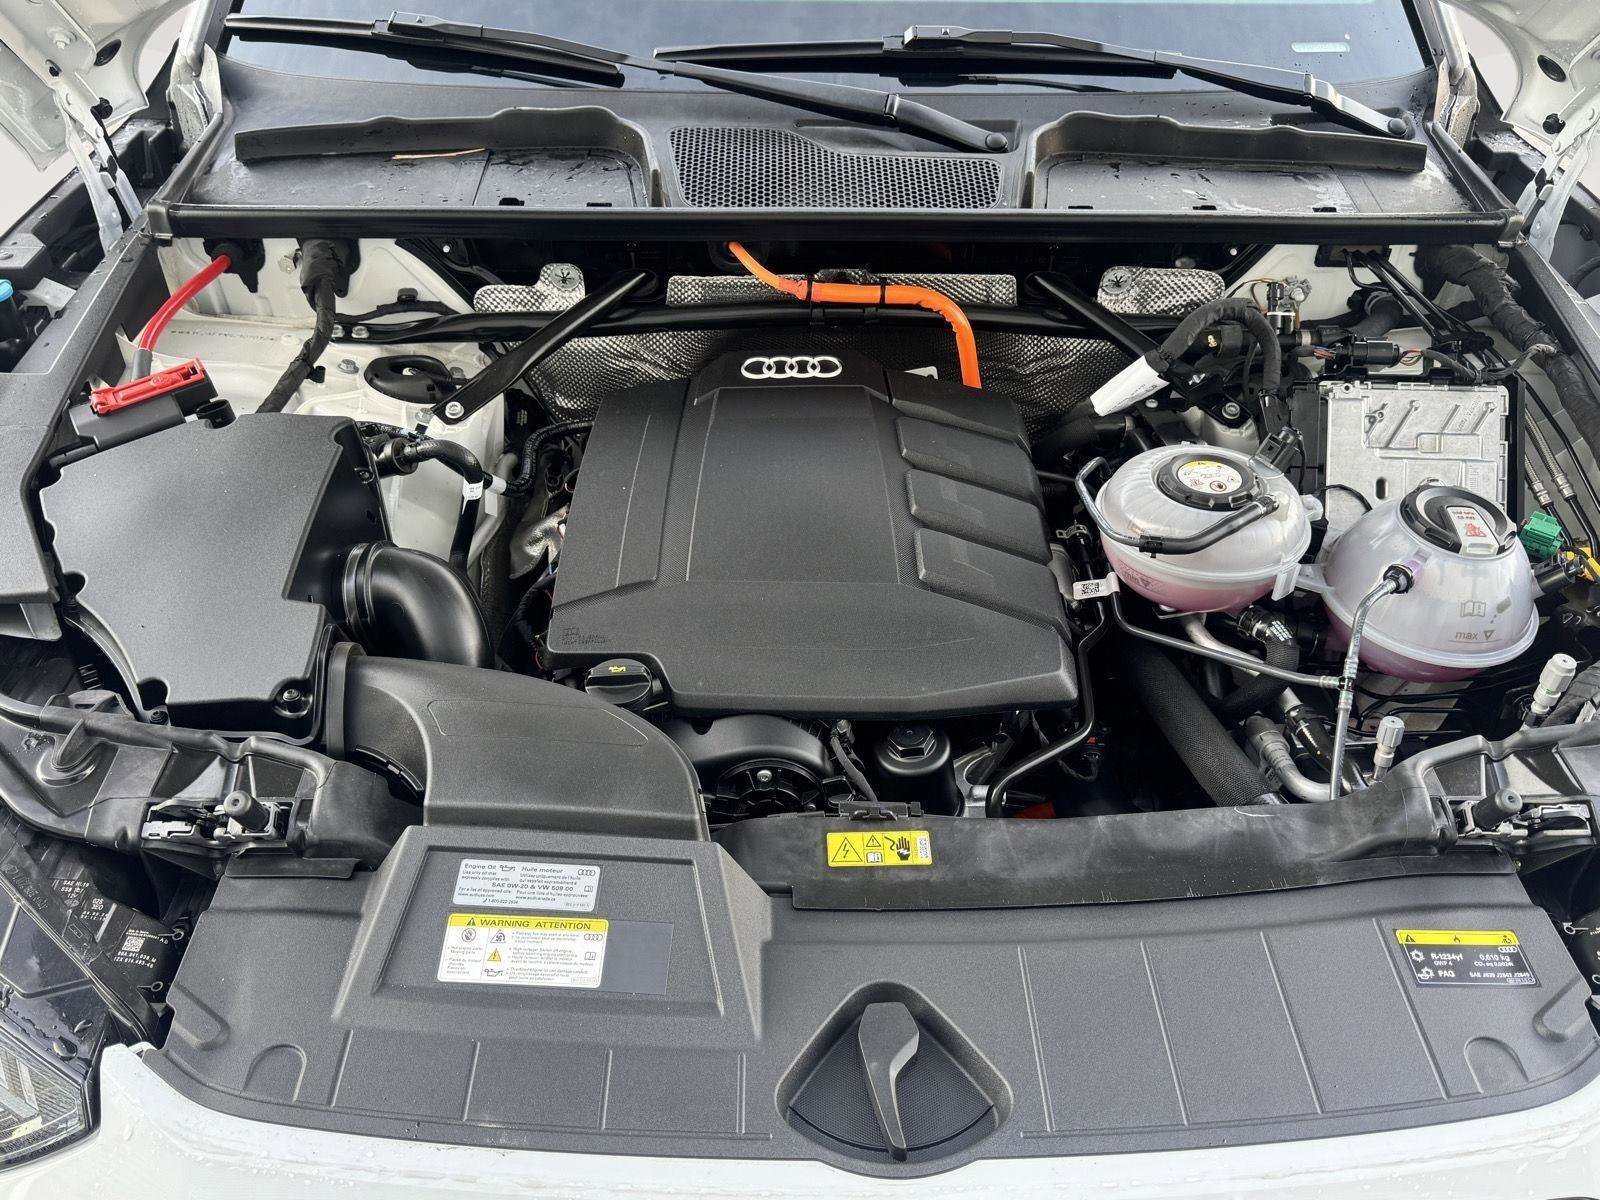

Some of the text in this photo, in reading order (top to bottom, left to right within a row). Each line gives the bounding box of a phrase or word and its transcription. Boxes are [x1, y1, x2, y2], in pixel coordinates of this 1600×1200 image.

[1455, 631, 1478, 640] max
[480, 919, 592, 930] WARNING ATTENTION
[1430, 952, 1463, 961] R-1234yf
[1500, 954, 1511, 962] kg
